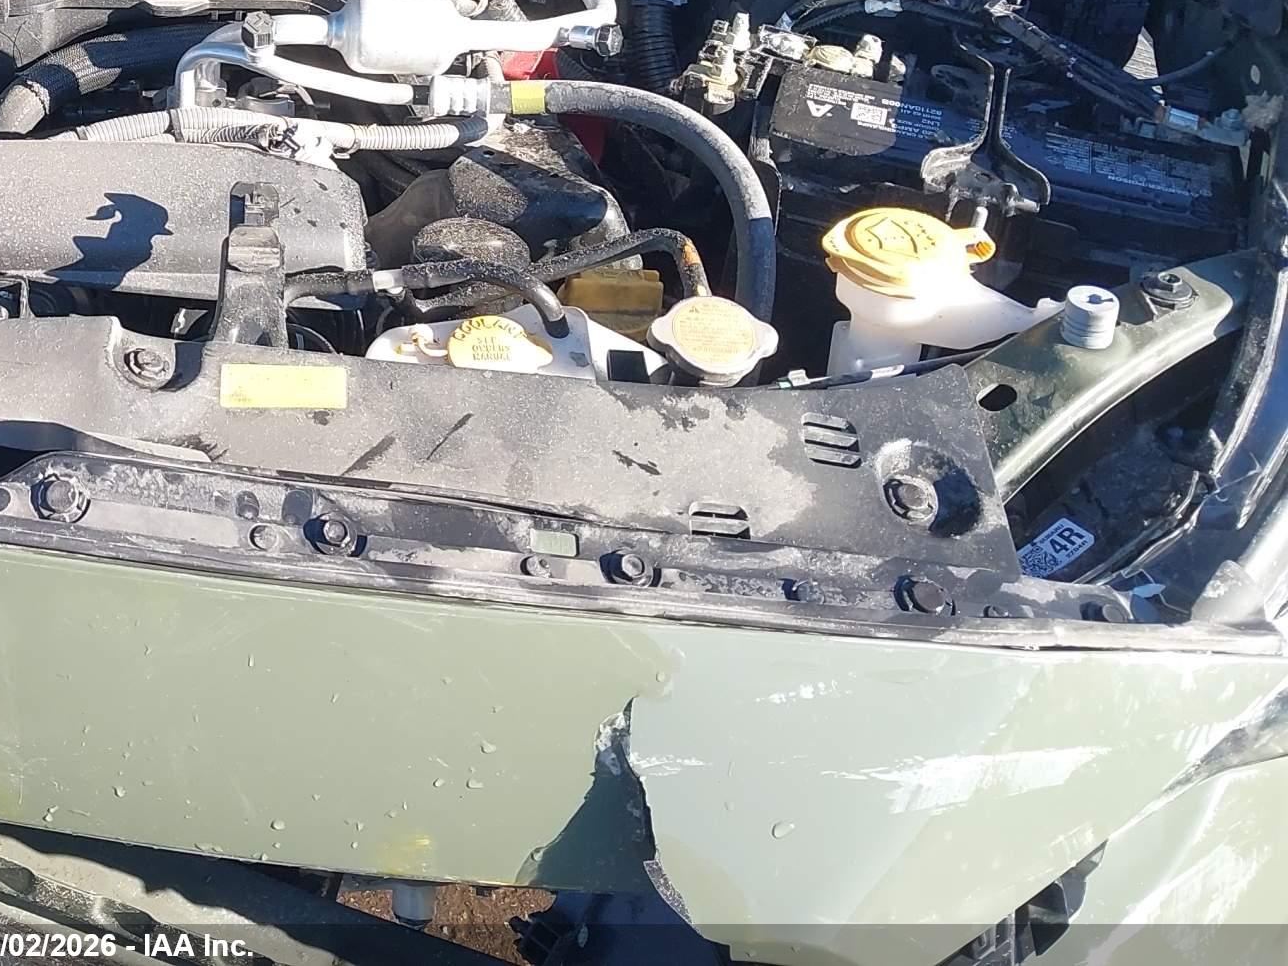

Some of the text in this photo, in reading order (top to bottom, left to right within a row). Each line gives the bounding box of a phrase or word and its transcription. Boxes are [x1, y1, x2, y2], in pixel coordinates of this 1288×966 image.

[921, 118, 940, 127] LN2
[1039, 523, 1065, 544] SUBARU
[1050, 527, 1085, 554] 4R
